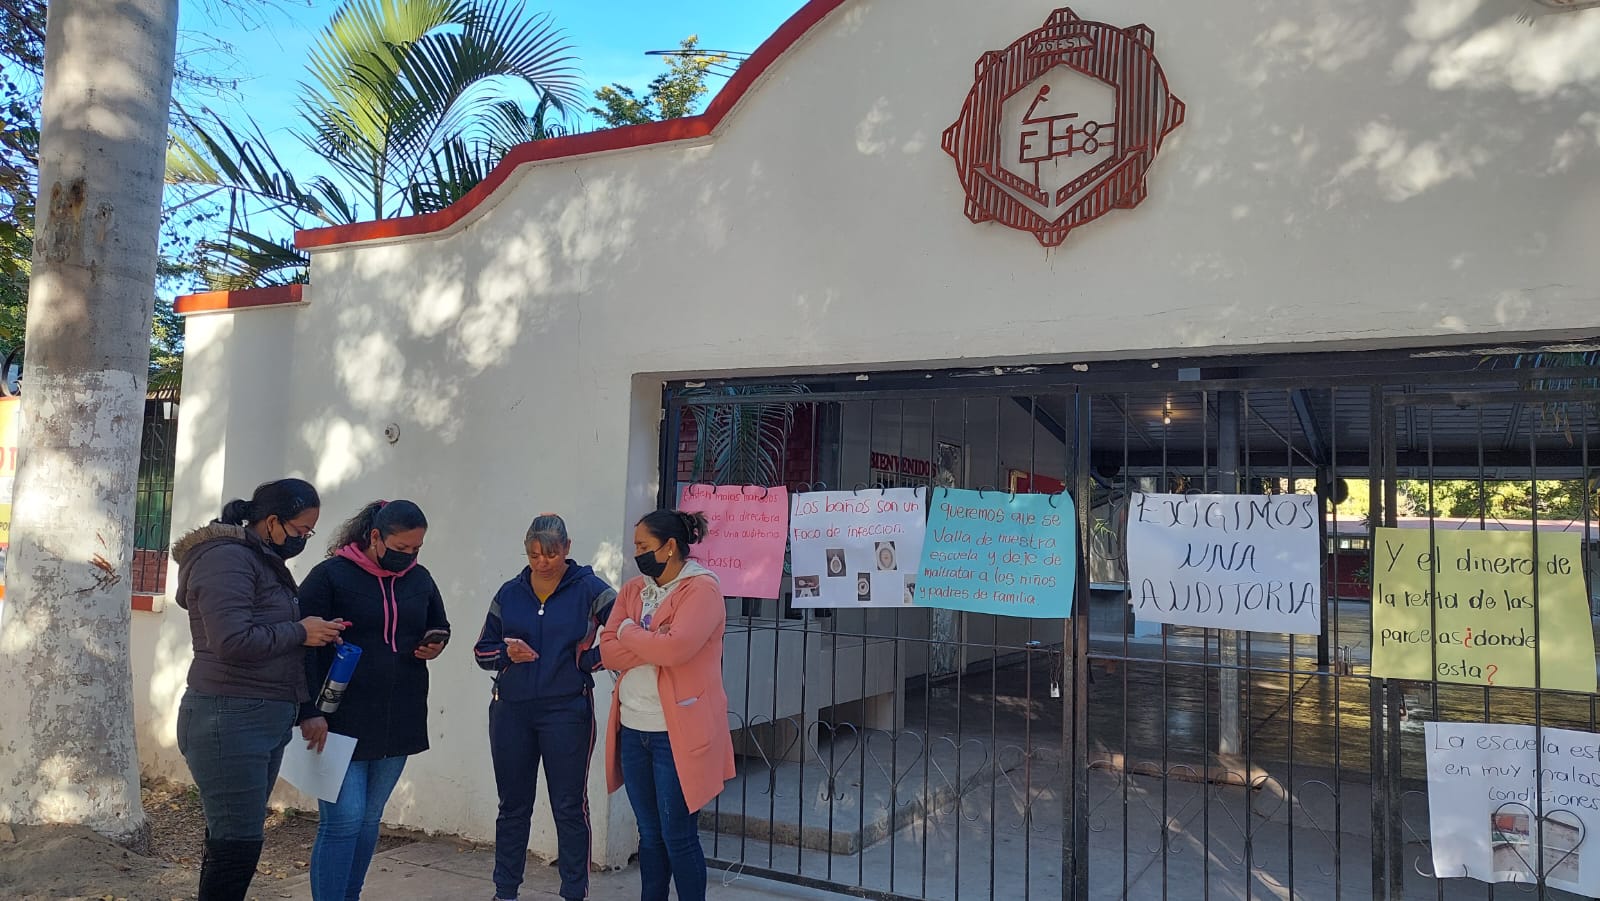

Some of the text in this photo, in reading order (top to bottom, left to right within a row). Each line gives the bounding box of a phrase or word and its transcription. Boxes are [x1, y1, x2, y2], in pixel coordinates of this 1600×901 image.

[871, 452, 937, 477] BIENVENIDOS
[795, 496, 919, 516] Los baños son un
[1136, 493, 1314, 533] EXIGIMOS
[1011, 512, 1036, 526] que
[1041, 514, 1061, 527] se
[826, 523, 840, 538] de
[975, 531, 993, 546] de
[998, 534, 1057, 550] nuestra
[929, 549, 979, 562] escuela
[987, 551, 997, 566] y
[1043, 553, 1062, 566] de
[1177, 542, 1260, 574] UNA
[1417, 551, 1441, 573] el
[1456, 548, 1535, 575] dinero
[1546, 554, 1572, 575] de
[978, 572, 988, 583] a
[994, 567, 1015, 586] los
[1019, 574, 1057, 588] niños
[919, 586, 926, 599] y
[928, 586, 969, 600] padres
[973, 587, 988, 600] de
[1138, 577, 1320, 620] AUDITORIA
[1379, 583, 1395, 607] la
[1468, 588, 1497, 609] de
[1381, 628, 1463, 648] parceas
[1434, 724, 1465, 751] La
[1476, 735, 1560, 755] escuela
[1445, 763, 1471, 777] en
[1482, 764, 1521, 778] muy
